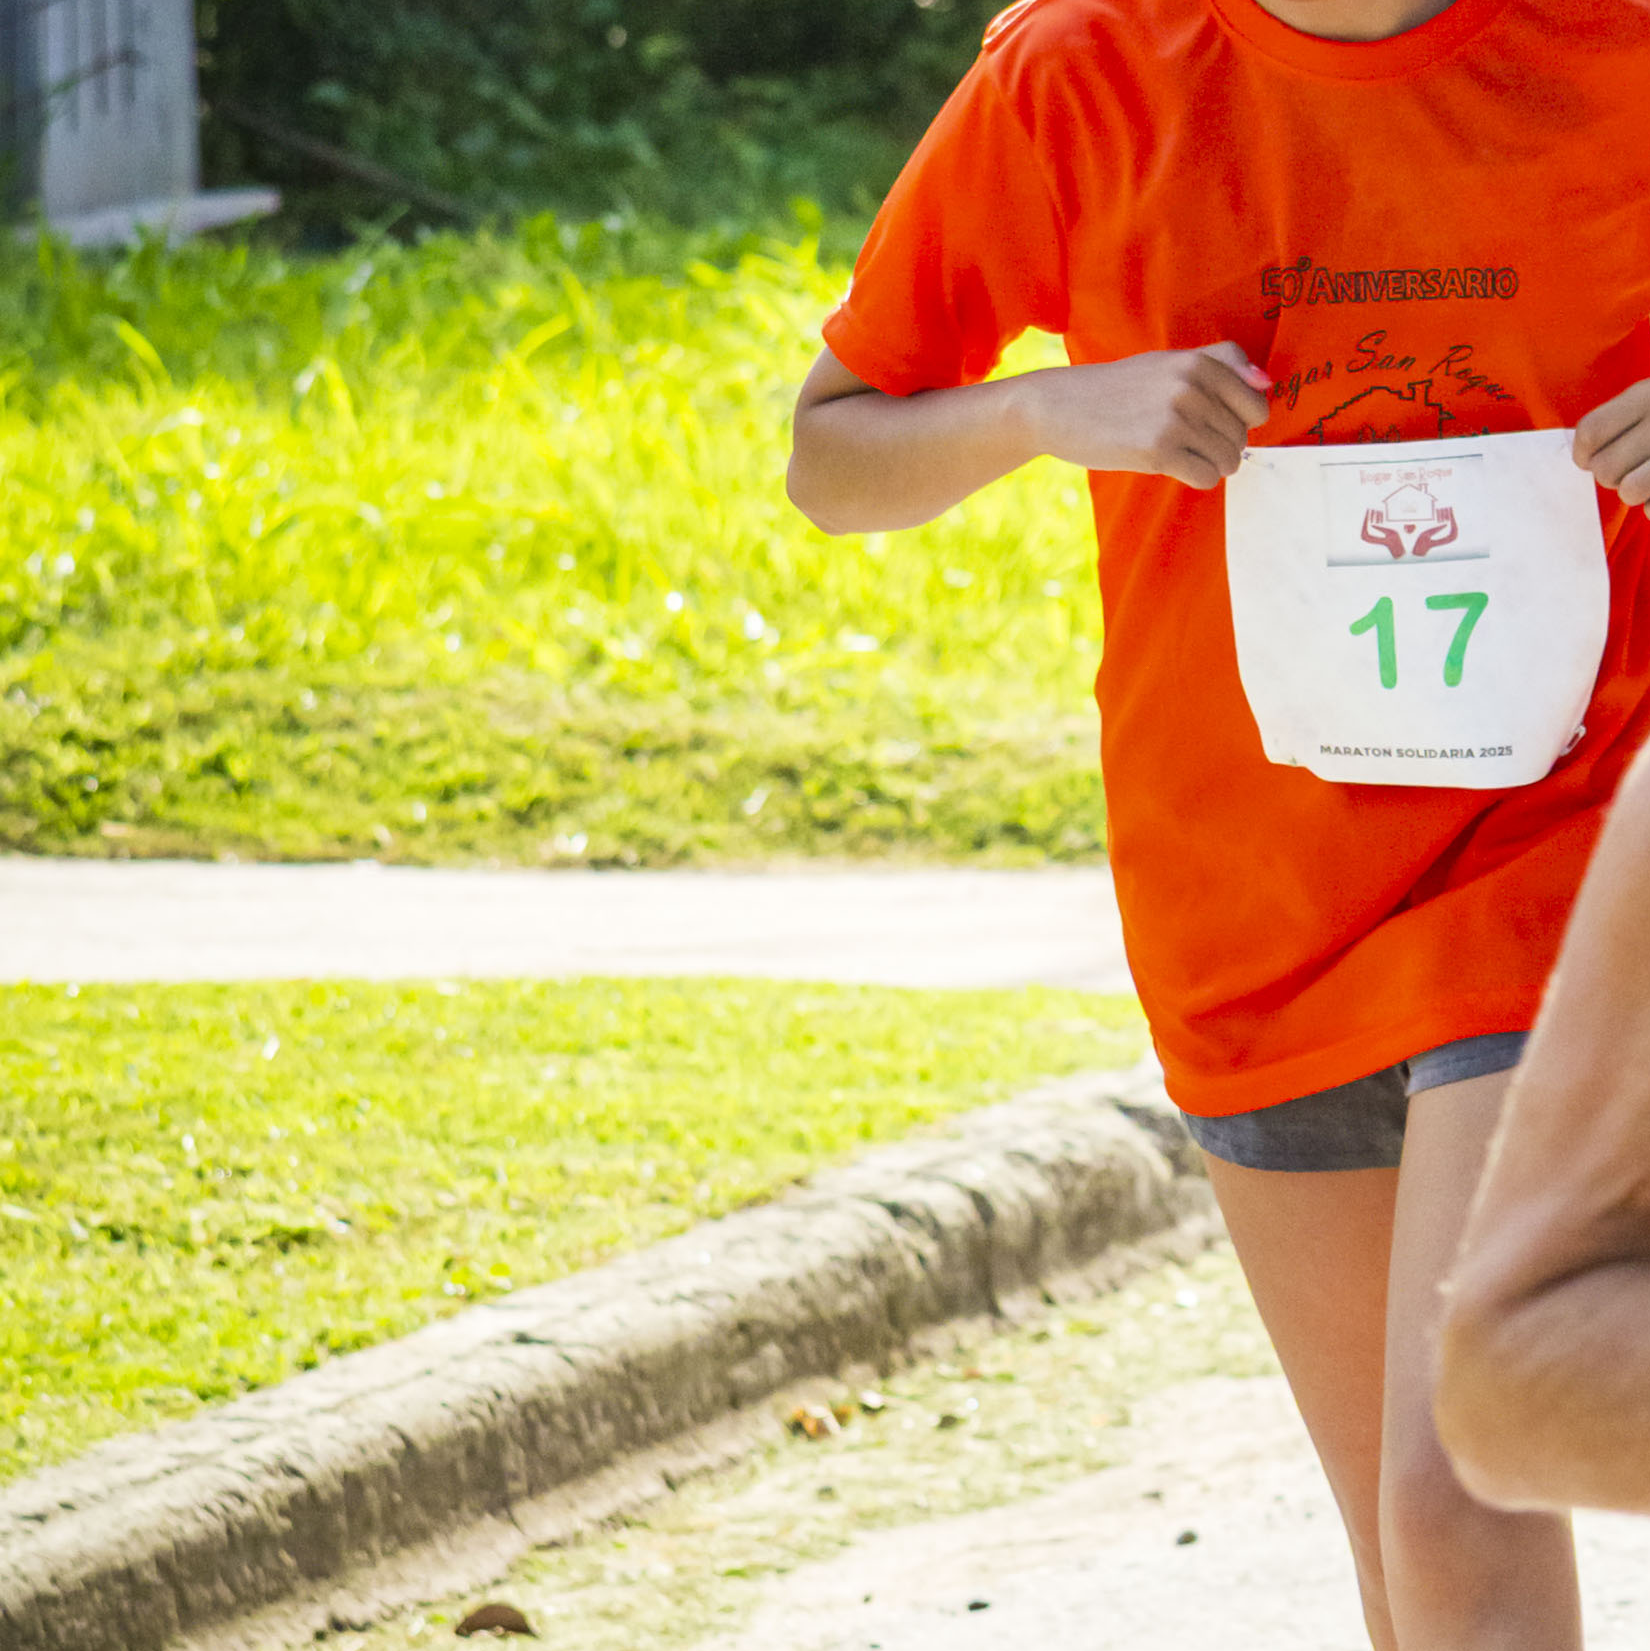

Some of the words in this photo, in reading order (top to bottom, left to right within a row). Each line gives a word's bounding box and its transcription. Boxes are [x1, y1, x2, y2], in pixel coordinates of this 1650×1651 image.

[1307, 267, 1519, 304] ANIVERSARIO
[1272, 360, 1333, 410] ogar
[1346, 329, 1416, 373] San
[1348, 591, 1490, 689] 17
[1320, 744, 1392, 758] MARATON
[1396, 747, 1475, 759] SOLIDARIA
[1480, 745, 1513, 758] 2025
